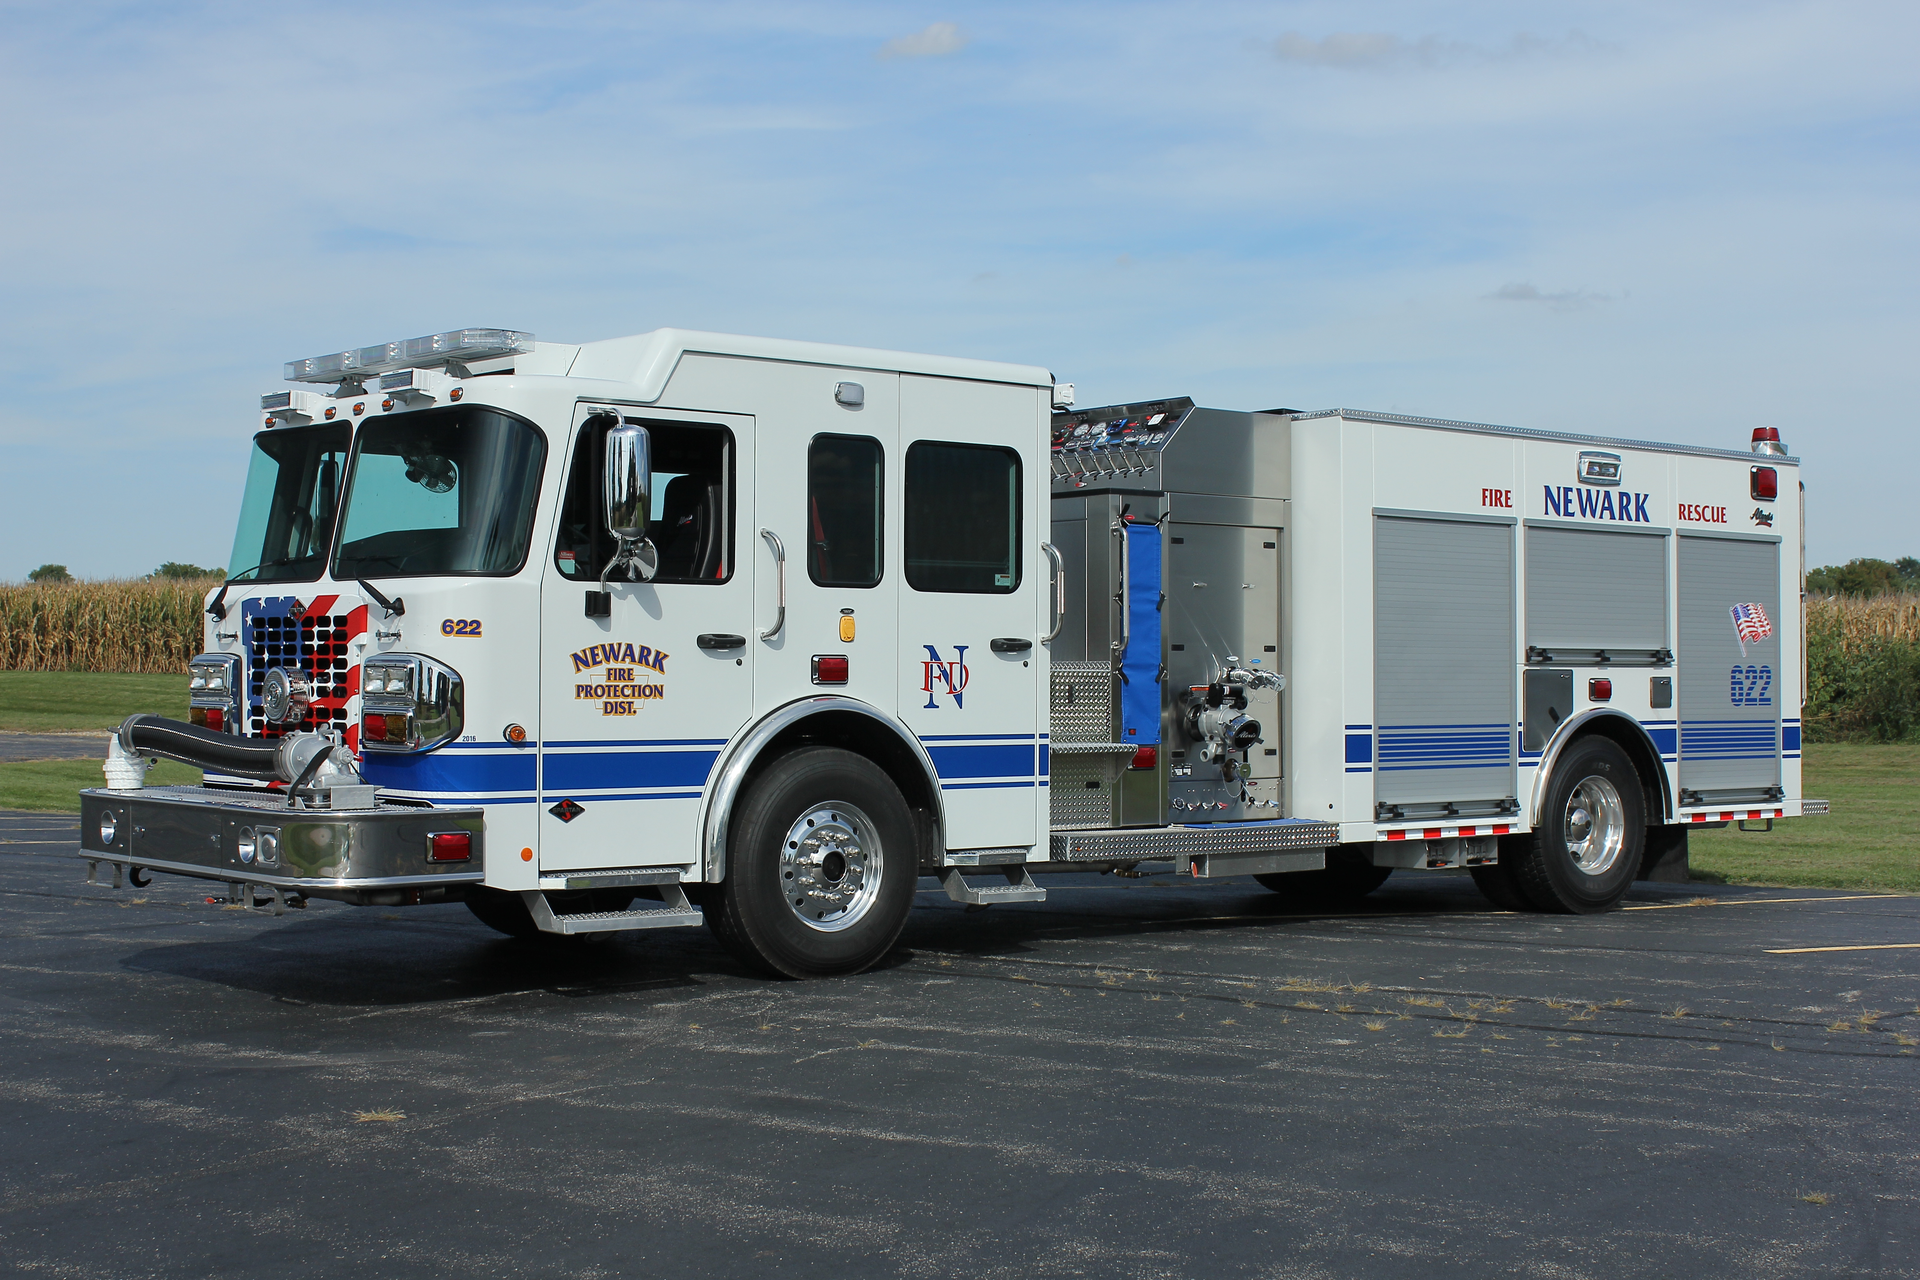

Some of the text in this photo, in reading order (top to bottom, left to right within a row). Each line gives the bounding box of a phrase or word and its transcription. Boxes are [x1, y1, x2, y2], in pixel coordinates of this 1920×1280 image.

[1482, 485, 1728, 523] FIRE NEWARK RESCUE
[440, 618, 482, 638] 622
[569, 642, 670, 675] NEWARK
[605, 667, 634, 683] FIRE
[574, 684, 664, 700] PROTECTION
[1730, 665, 1772, 707] 622
[602, 701, 637, 717] DIST.
